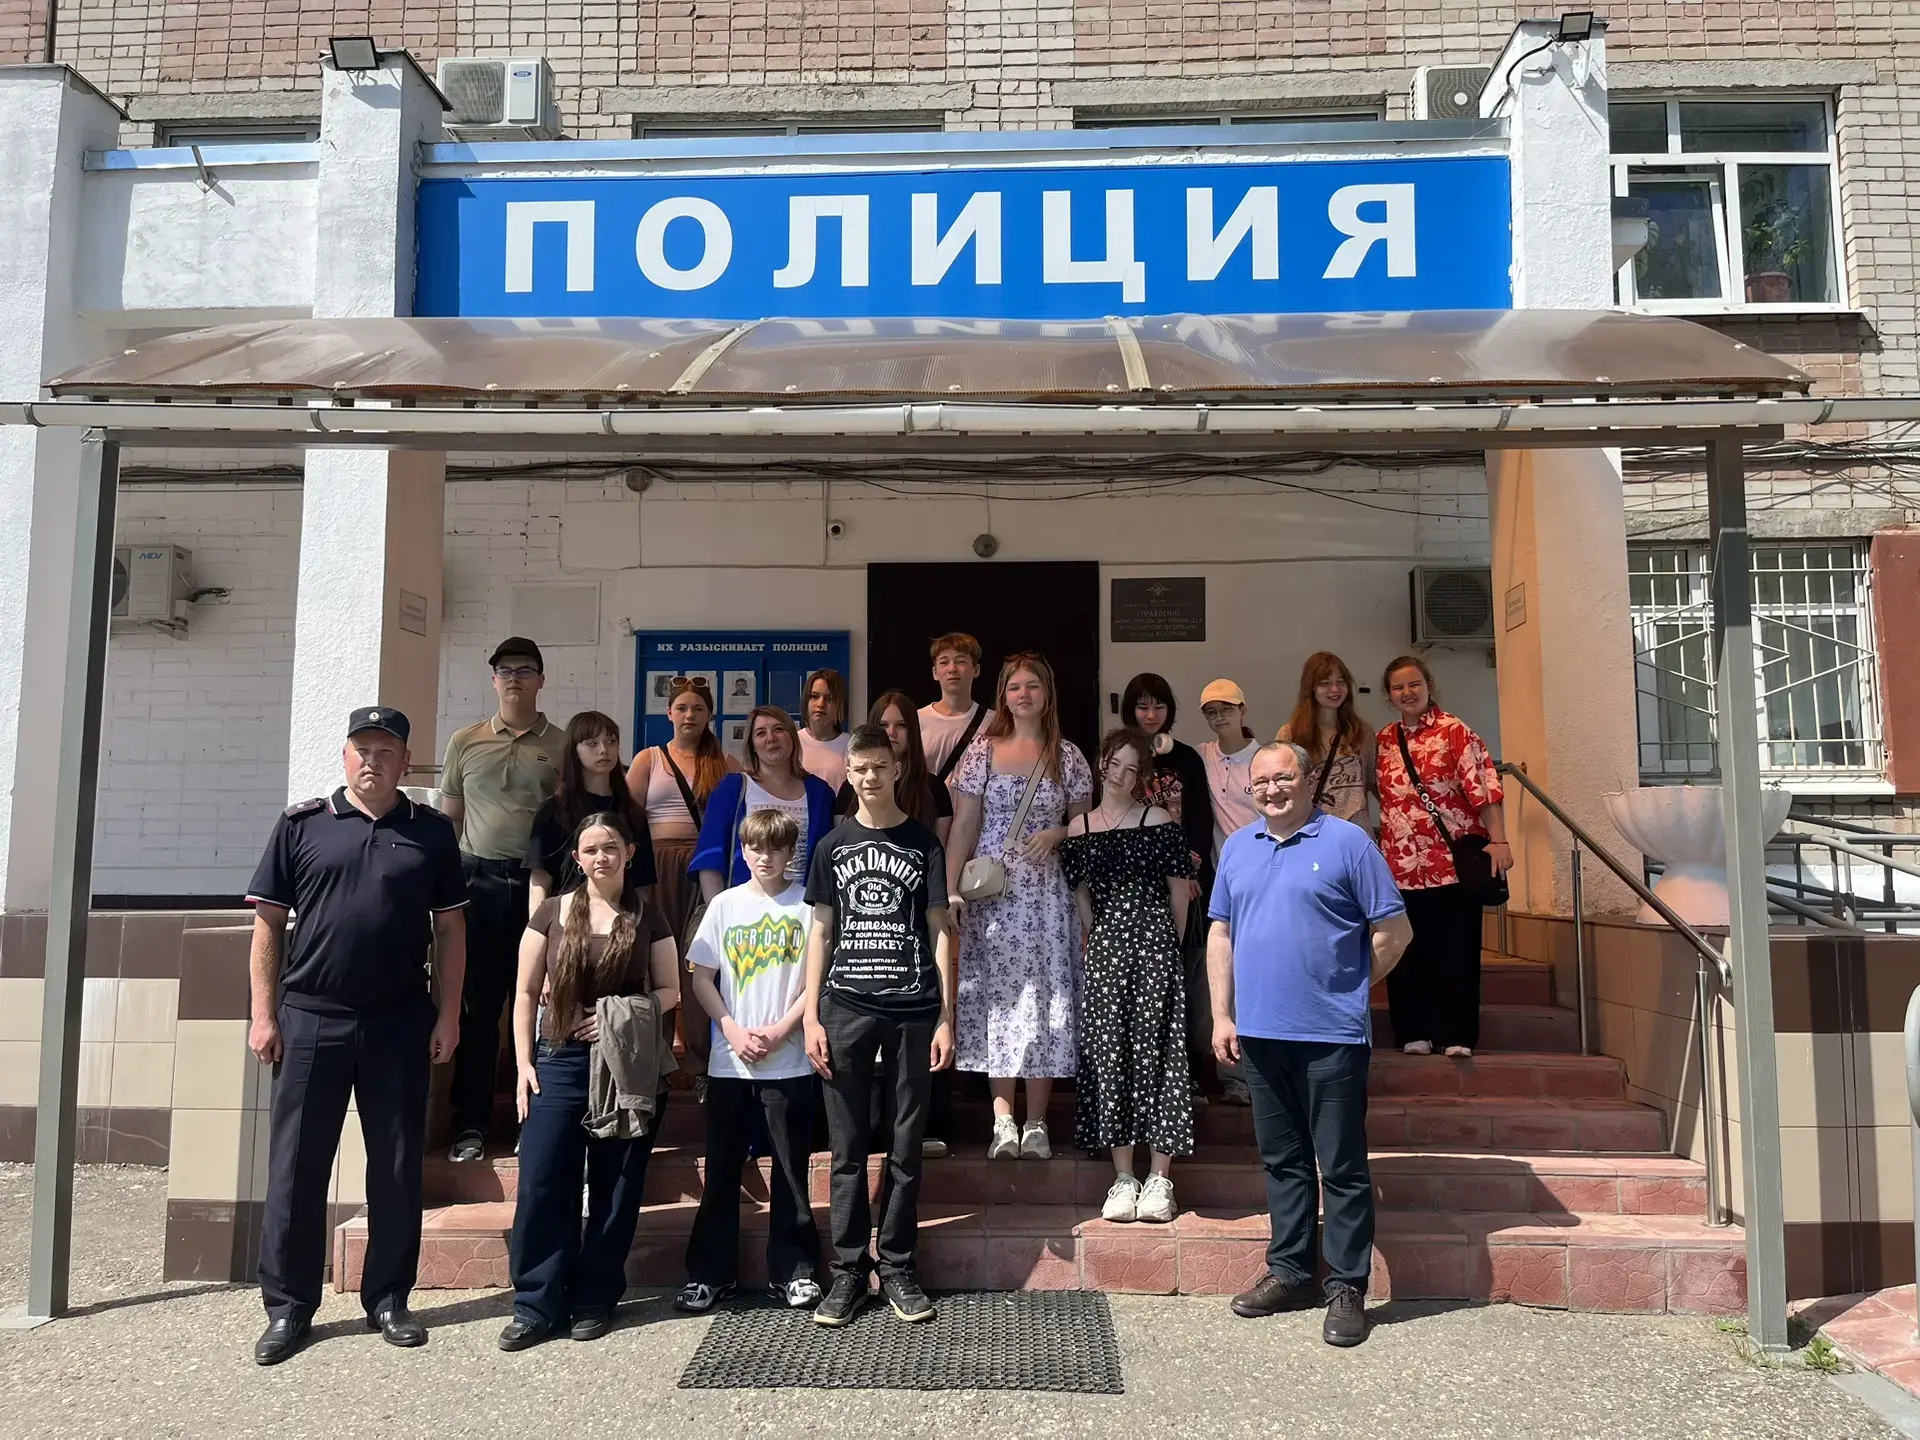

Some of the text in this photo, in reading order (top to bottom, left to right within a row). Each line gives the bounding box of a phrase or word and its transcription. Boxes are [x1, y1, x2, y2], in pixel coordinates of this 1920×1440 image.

[503, 183, 1418, 304] ПОЛИЦИЯ
[657, 643, 828, 653] ИХ РАЗЫСКИВАЕТ ПОЛИЦИЯ
[832, 847, 924, 892] JACK DANIEL'S
[867, 882, 882, 892] Old
[881, 892, 889, 903] 7
[843, 915, 906, 933] Tennessee
[727, 927, 802, 950] JORDAN
[840, 939, 905, 951] WHISKEY
